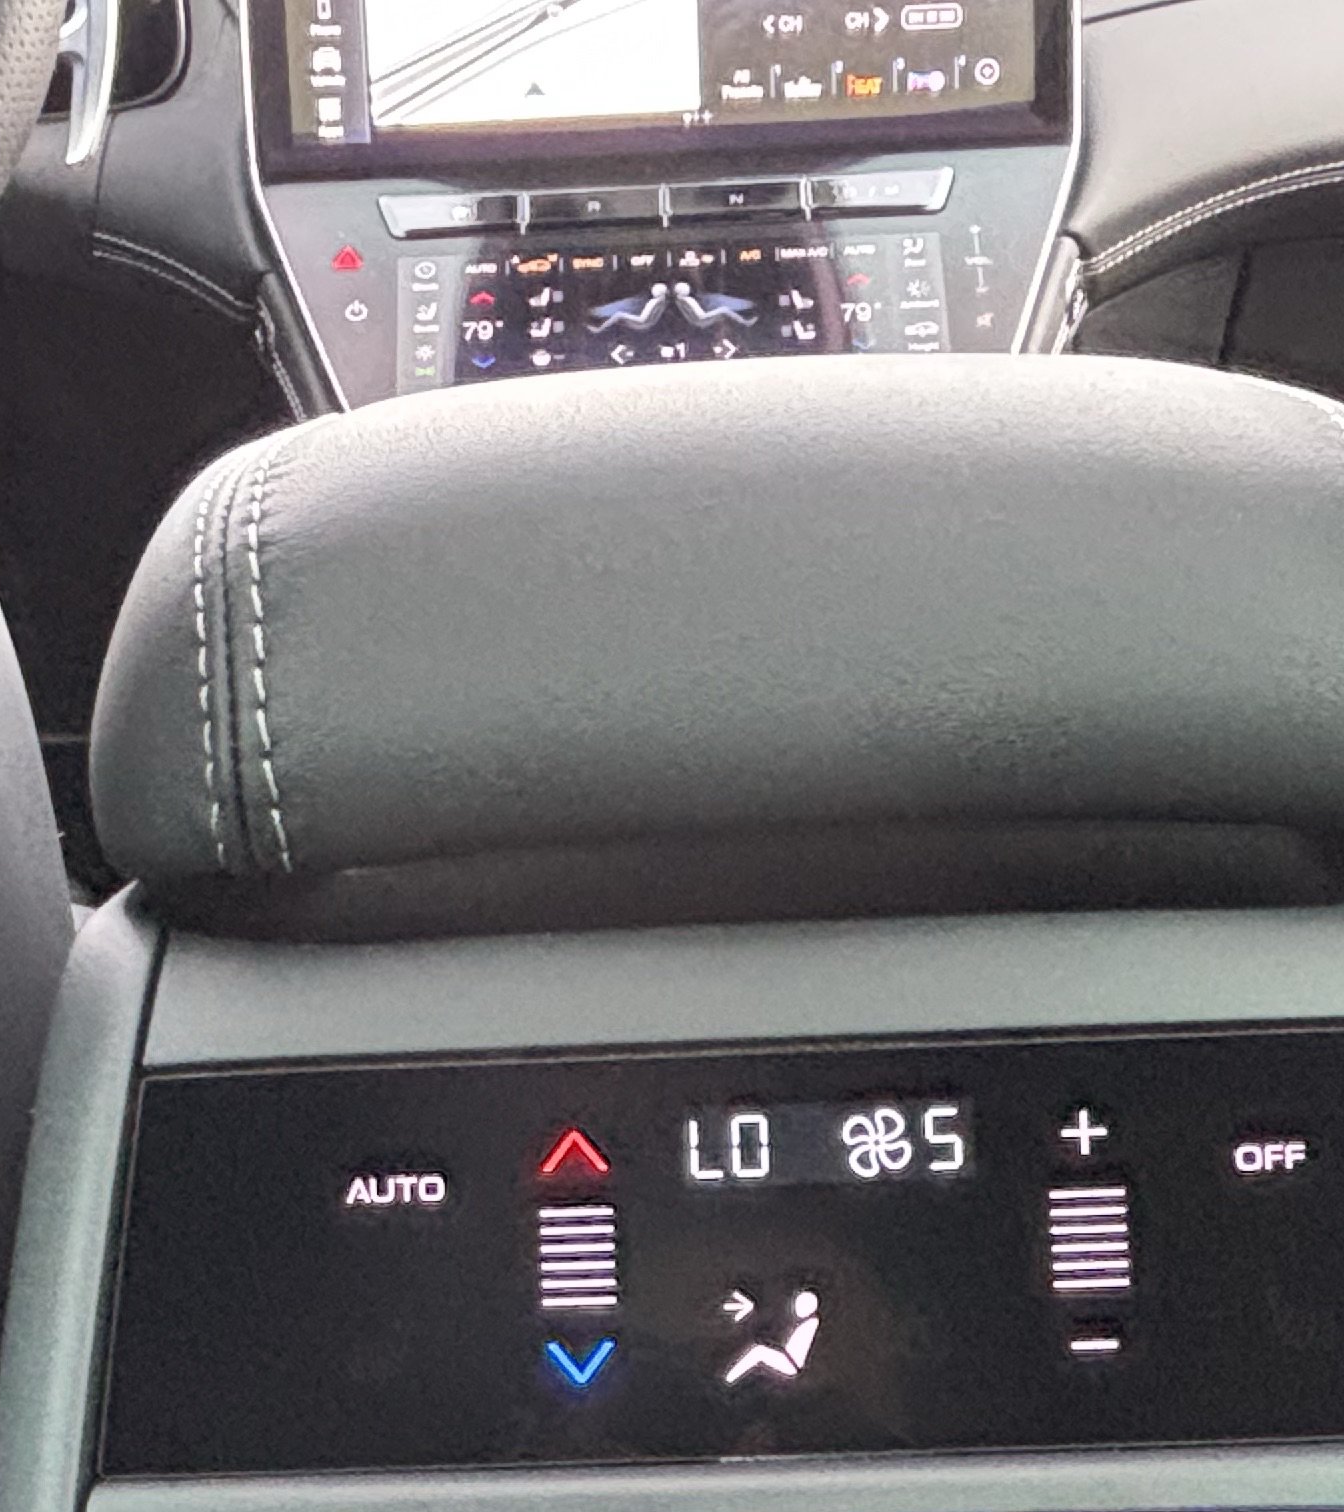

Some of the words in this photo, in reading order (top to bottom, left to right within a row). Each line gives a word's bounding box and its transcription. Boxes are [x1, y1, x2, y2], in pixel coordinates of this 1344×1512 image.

[687, 1113, 770, 1180] LO
[923, 1106, 964, 1171] 5
[1233, 1140, 1306, 1173] OFF
[345, 1172, 446, 1206] AUTO
